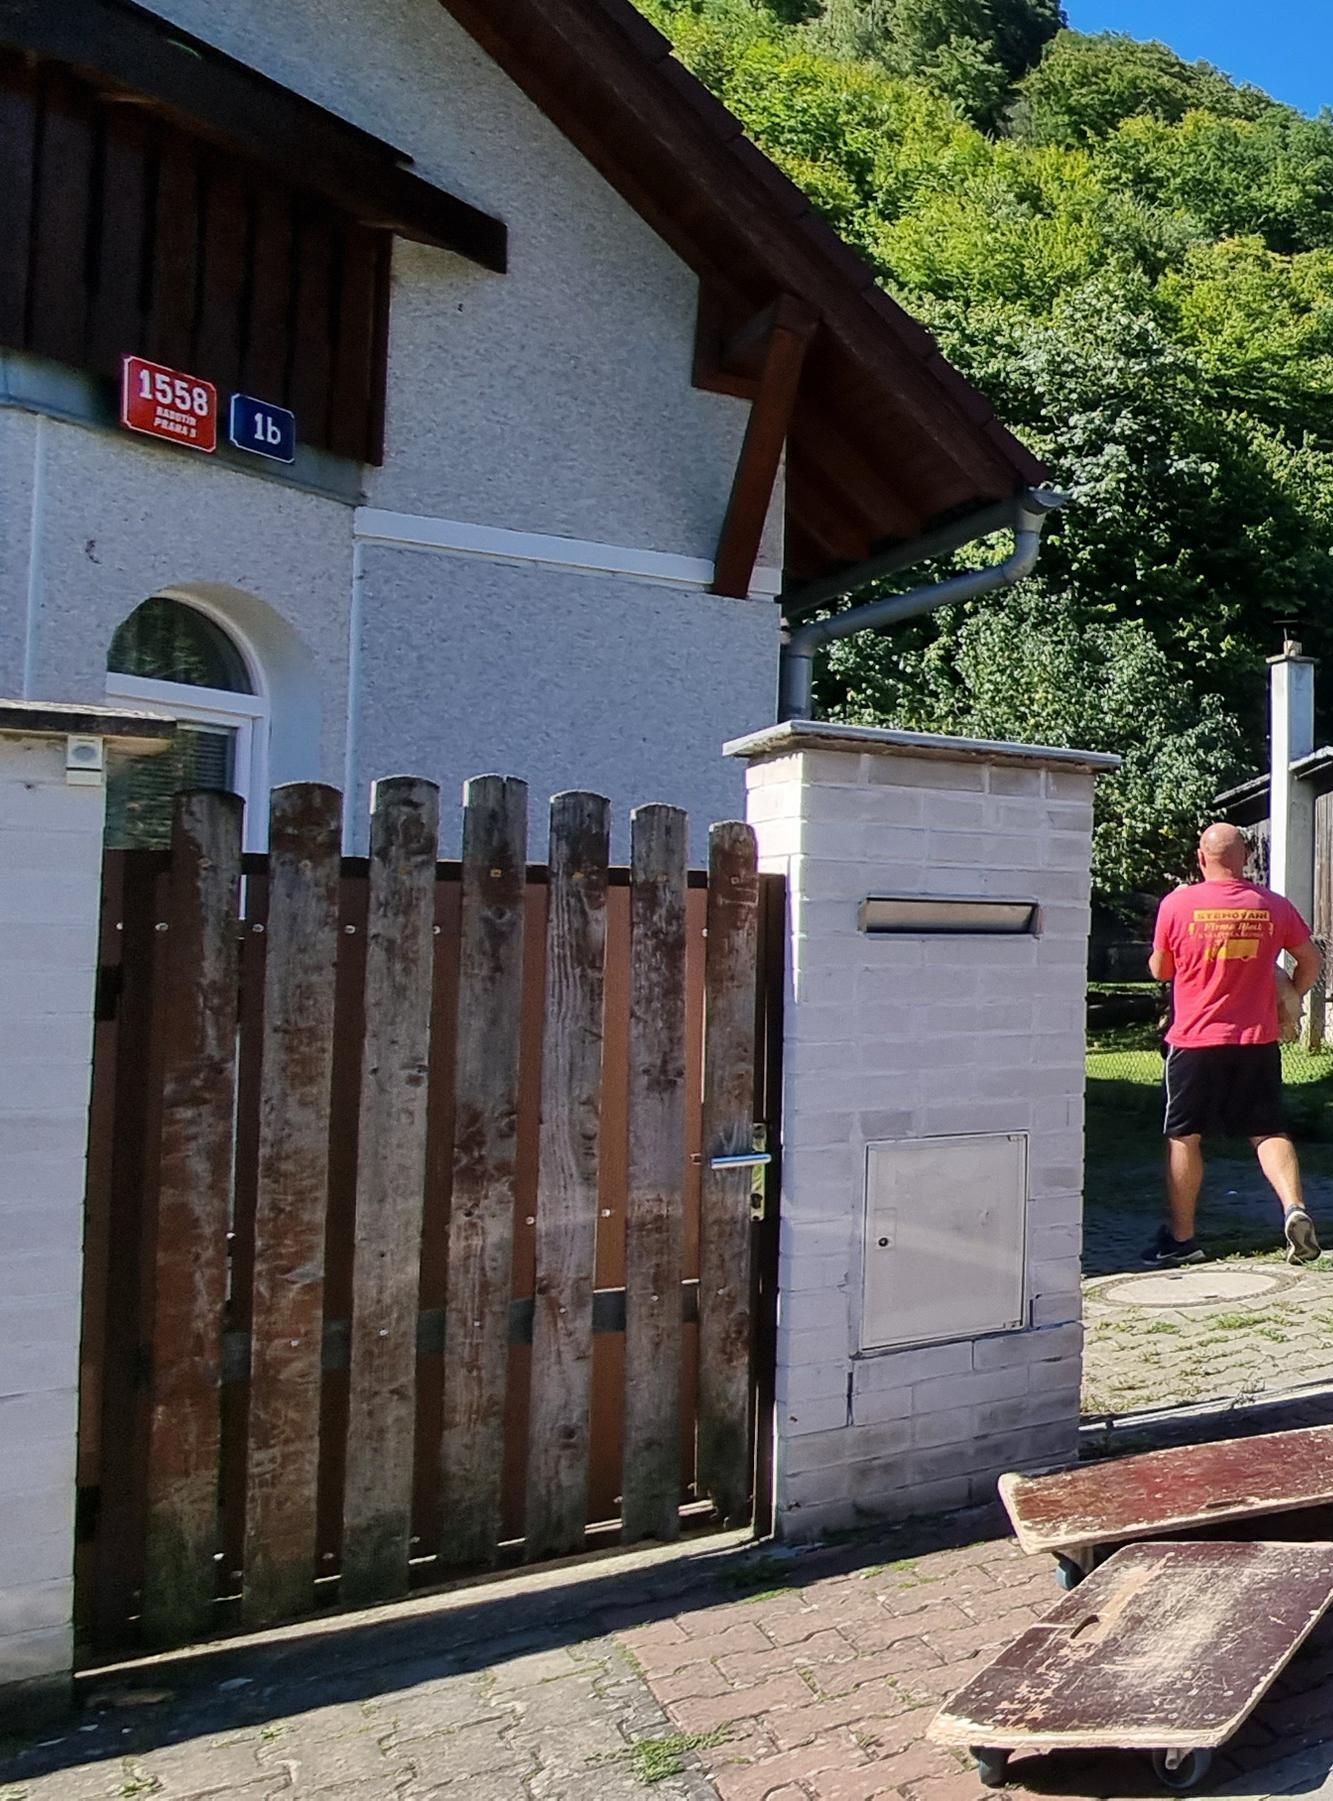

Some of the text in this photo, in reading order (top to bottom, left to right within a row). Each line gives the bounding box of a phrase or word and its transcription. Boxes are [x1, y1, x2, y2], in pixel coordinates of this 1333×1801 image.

[140, 369, 209, 417] 1558
[153, 417, 188, 436] PRAHA
[254, 412, 281, 445] 1b
